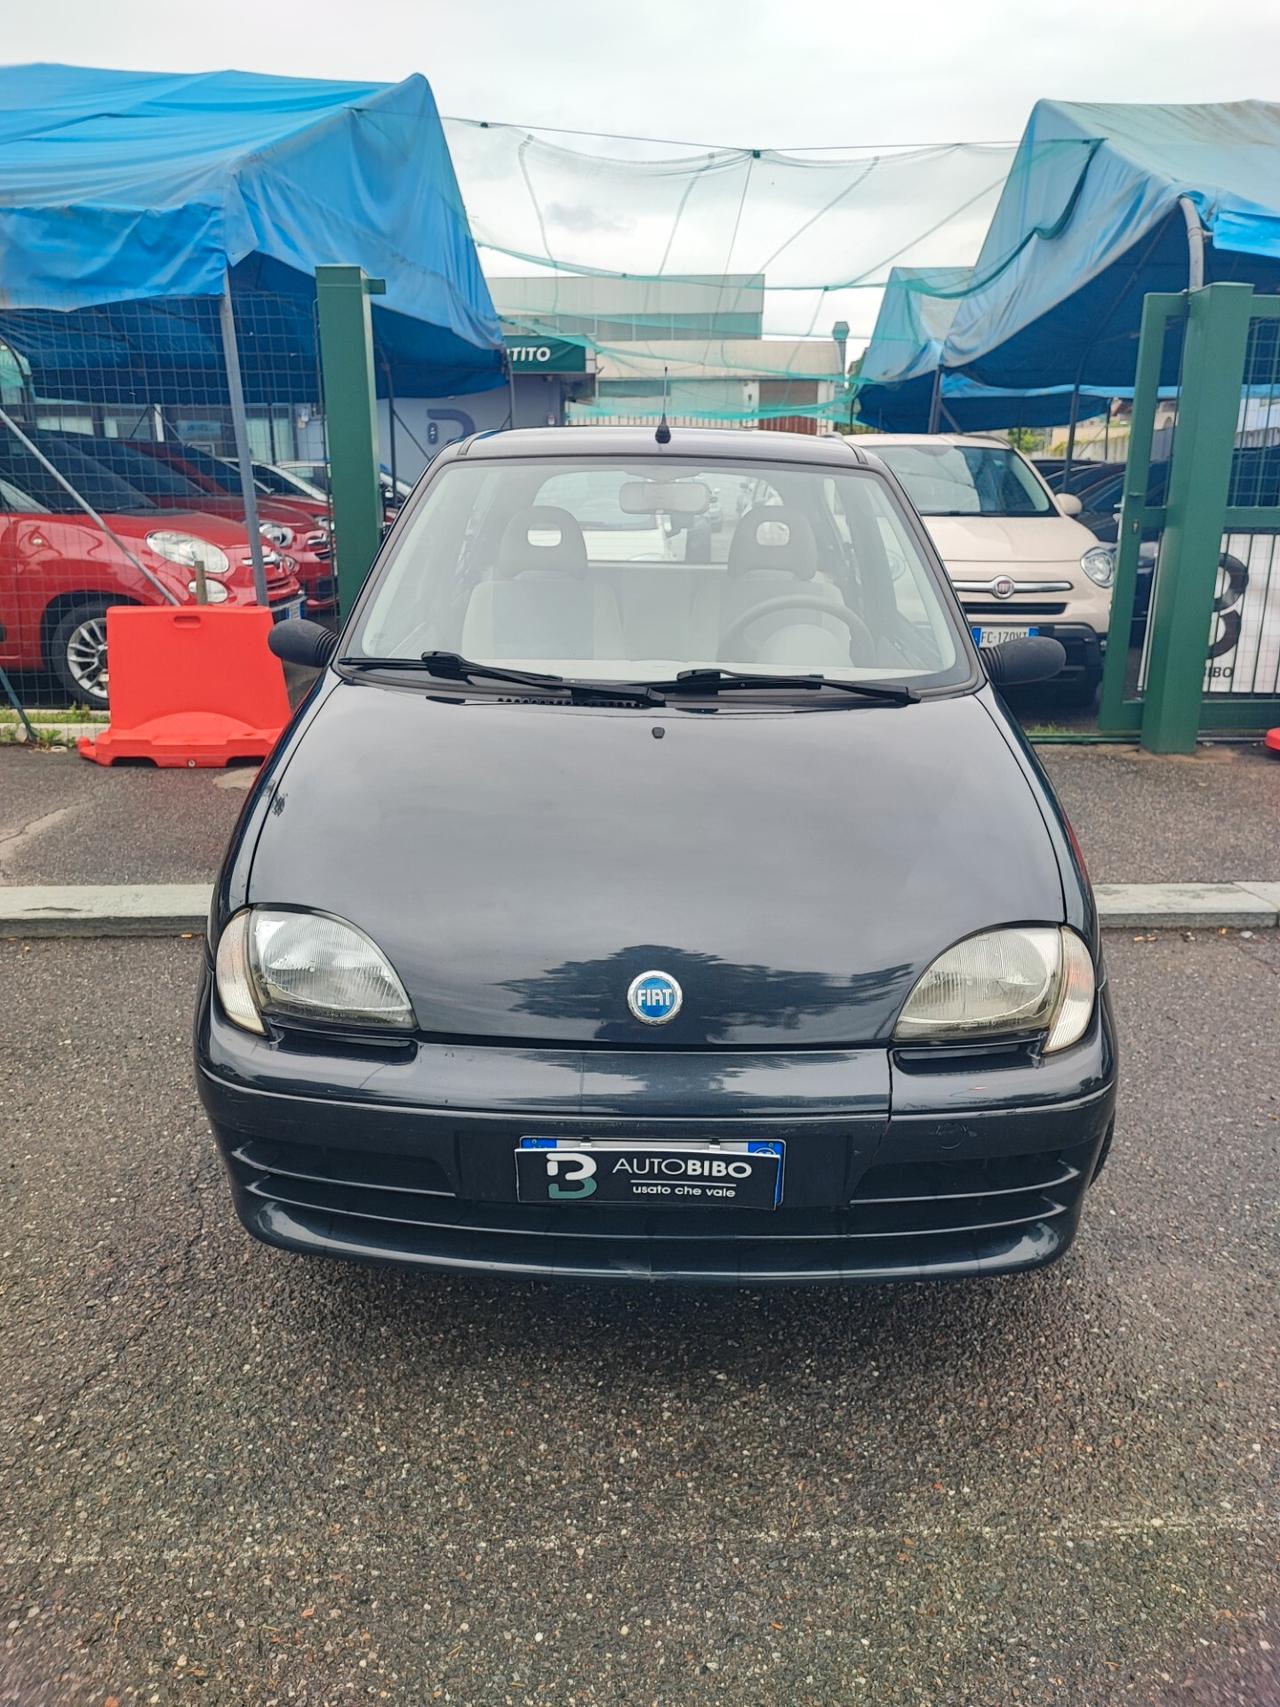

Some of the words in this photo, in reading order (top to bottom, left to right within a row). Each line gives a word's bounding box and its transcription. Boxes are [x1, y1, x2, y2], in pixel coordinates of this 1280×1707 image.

[506, 346, 551, 362] TITO
[1203, 666, 1234, 678] IBO
[637, 988, 673, 1006] FIAT
[612, 1157, 752, 1178] AUTOBIBO
[632, 1184, 671, 1194] usato
[674, 1186, 702, 1196] che
[706, 1187, 736, 1198] vale
